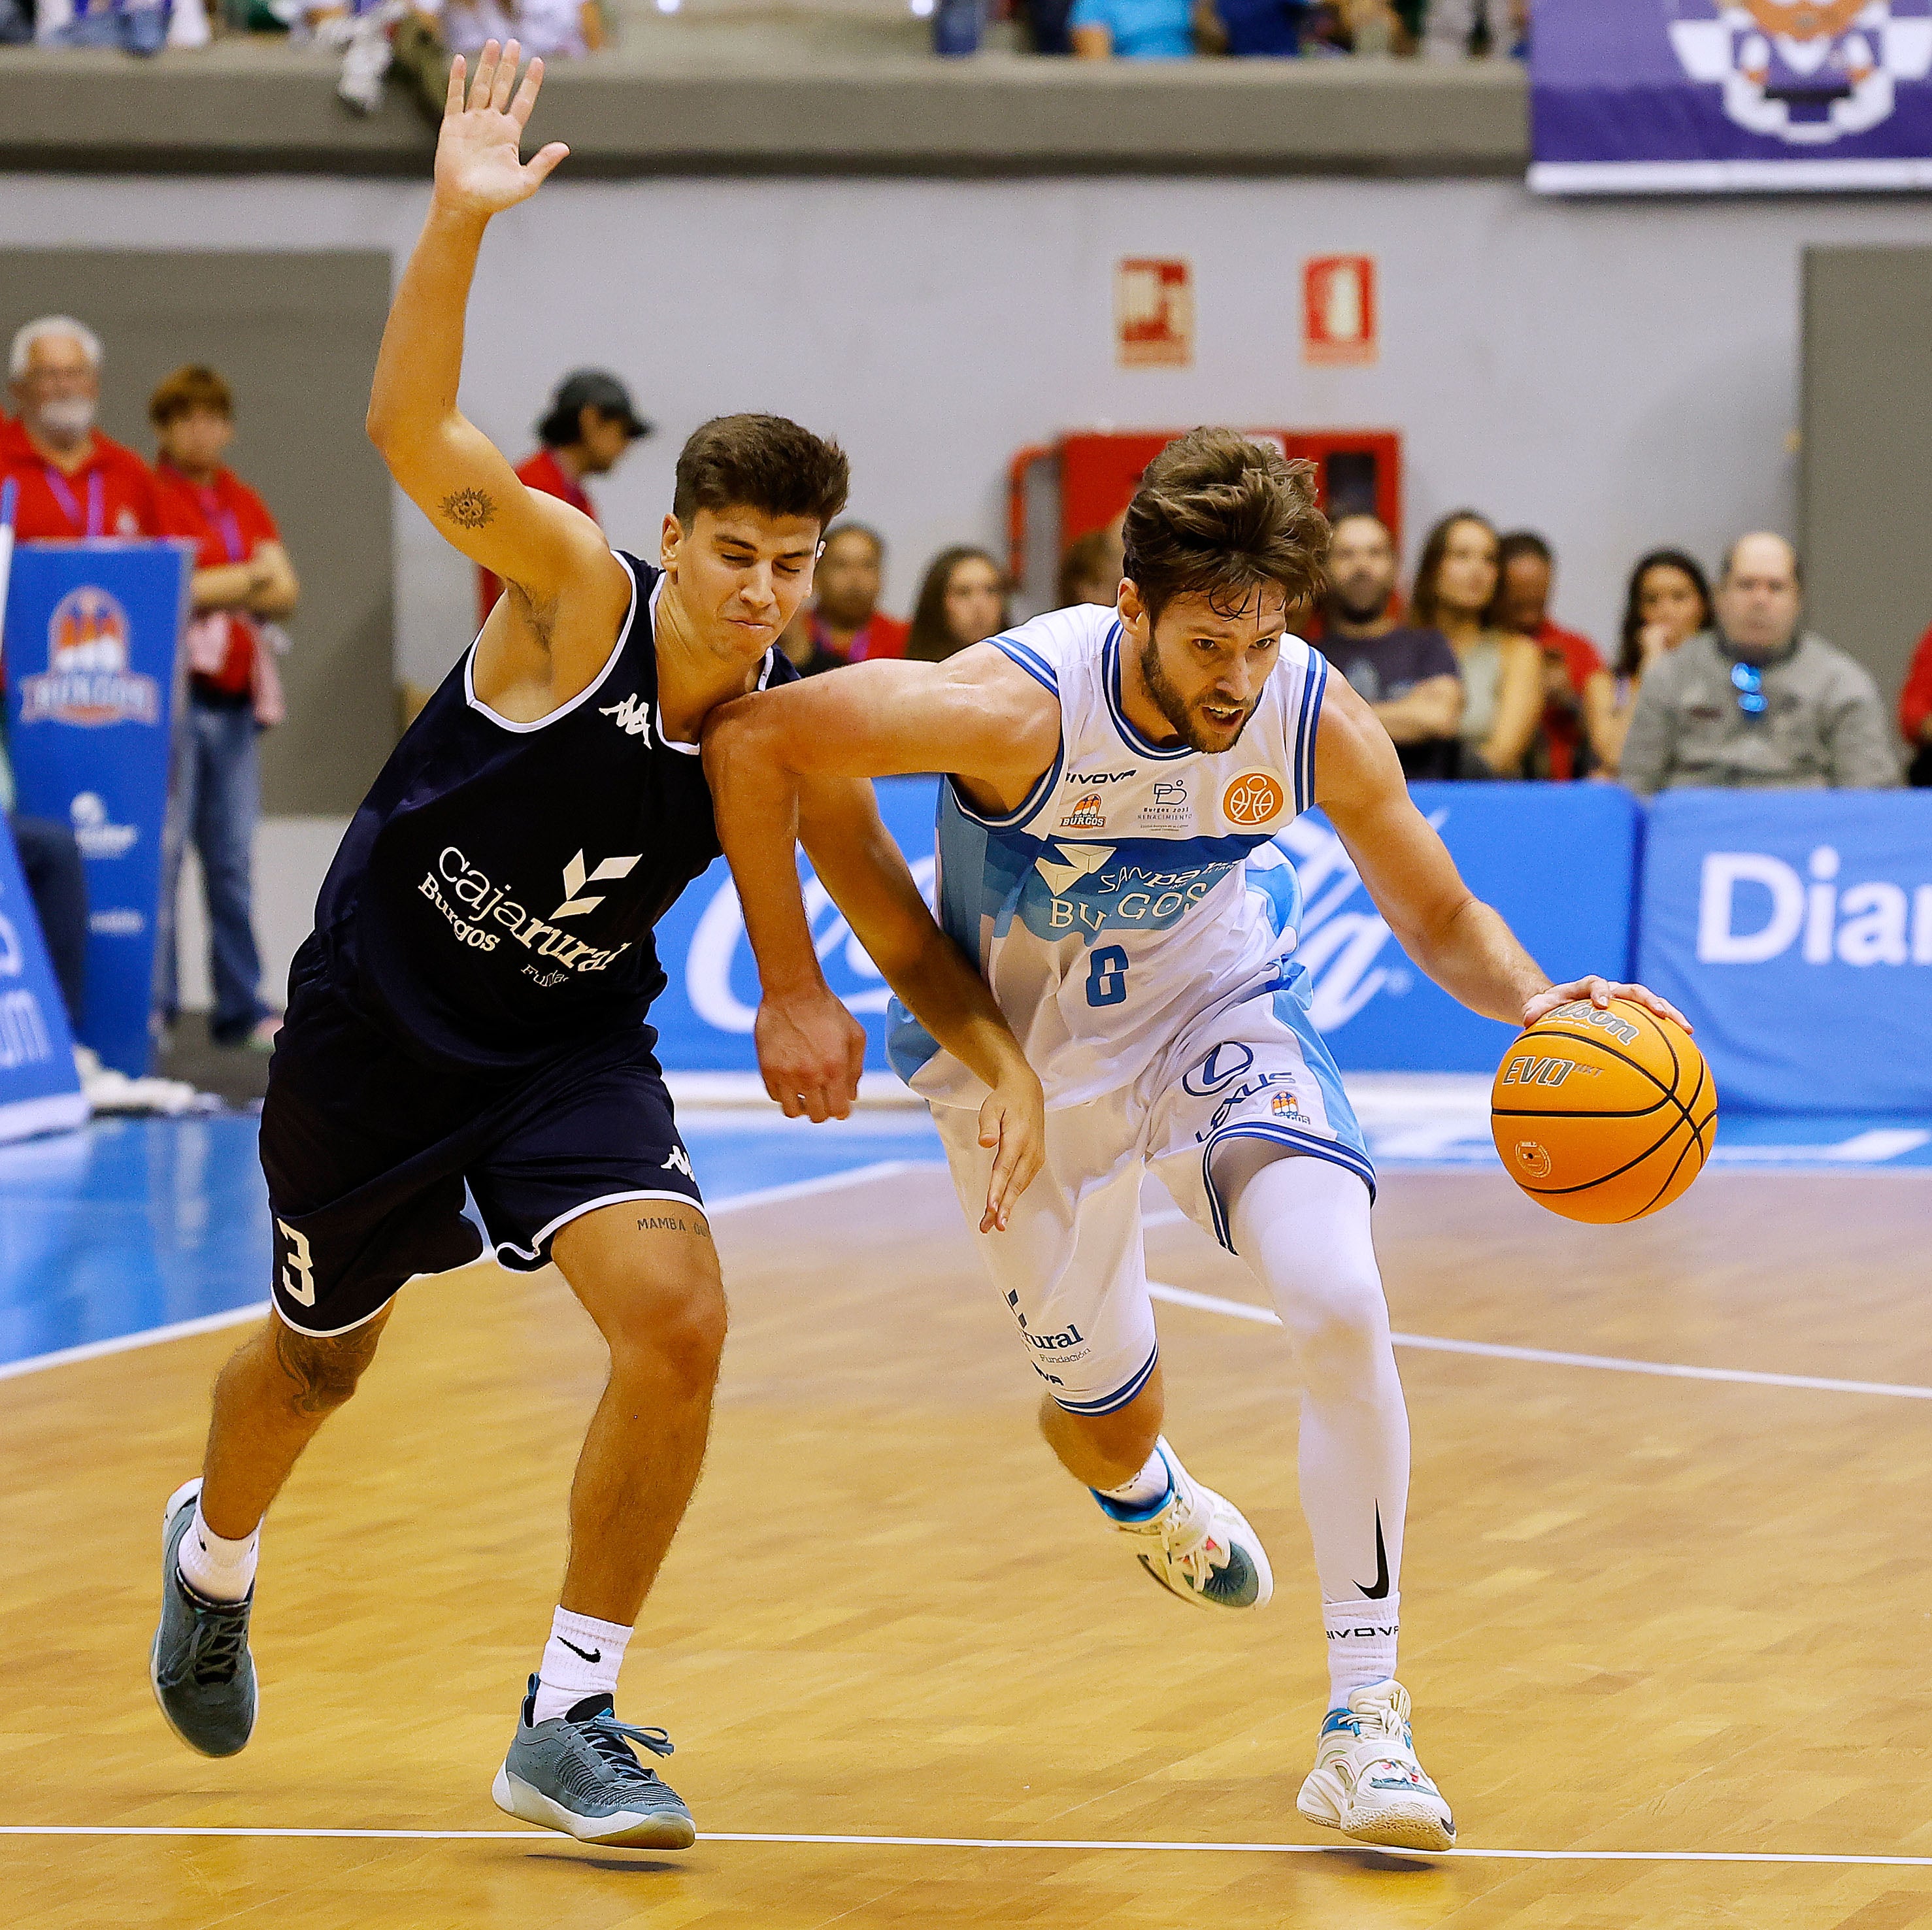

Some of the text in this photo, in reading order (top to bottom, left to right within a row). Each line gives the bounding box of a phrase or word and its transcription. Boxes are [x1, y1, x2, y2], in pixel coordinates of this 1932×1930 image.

[1062, 817, 1104, 826] BURGOS
[418, 873, 501, 952] Burgos
[1049, 882, 1207, 931] BUGOS
[1086, 944, 1129, 1007] 6
[1502, 1056, 1575, 1087] EVO
[1195, 1072, 1295, 1143] LEXUS
[637, 1217, 686, 1231] MAMBA
[276, 1218, 315, 1307] 3
[1039, 1348, 1091, 1363] Fundación
